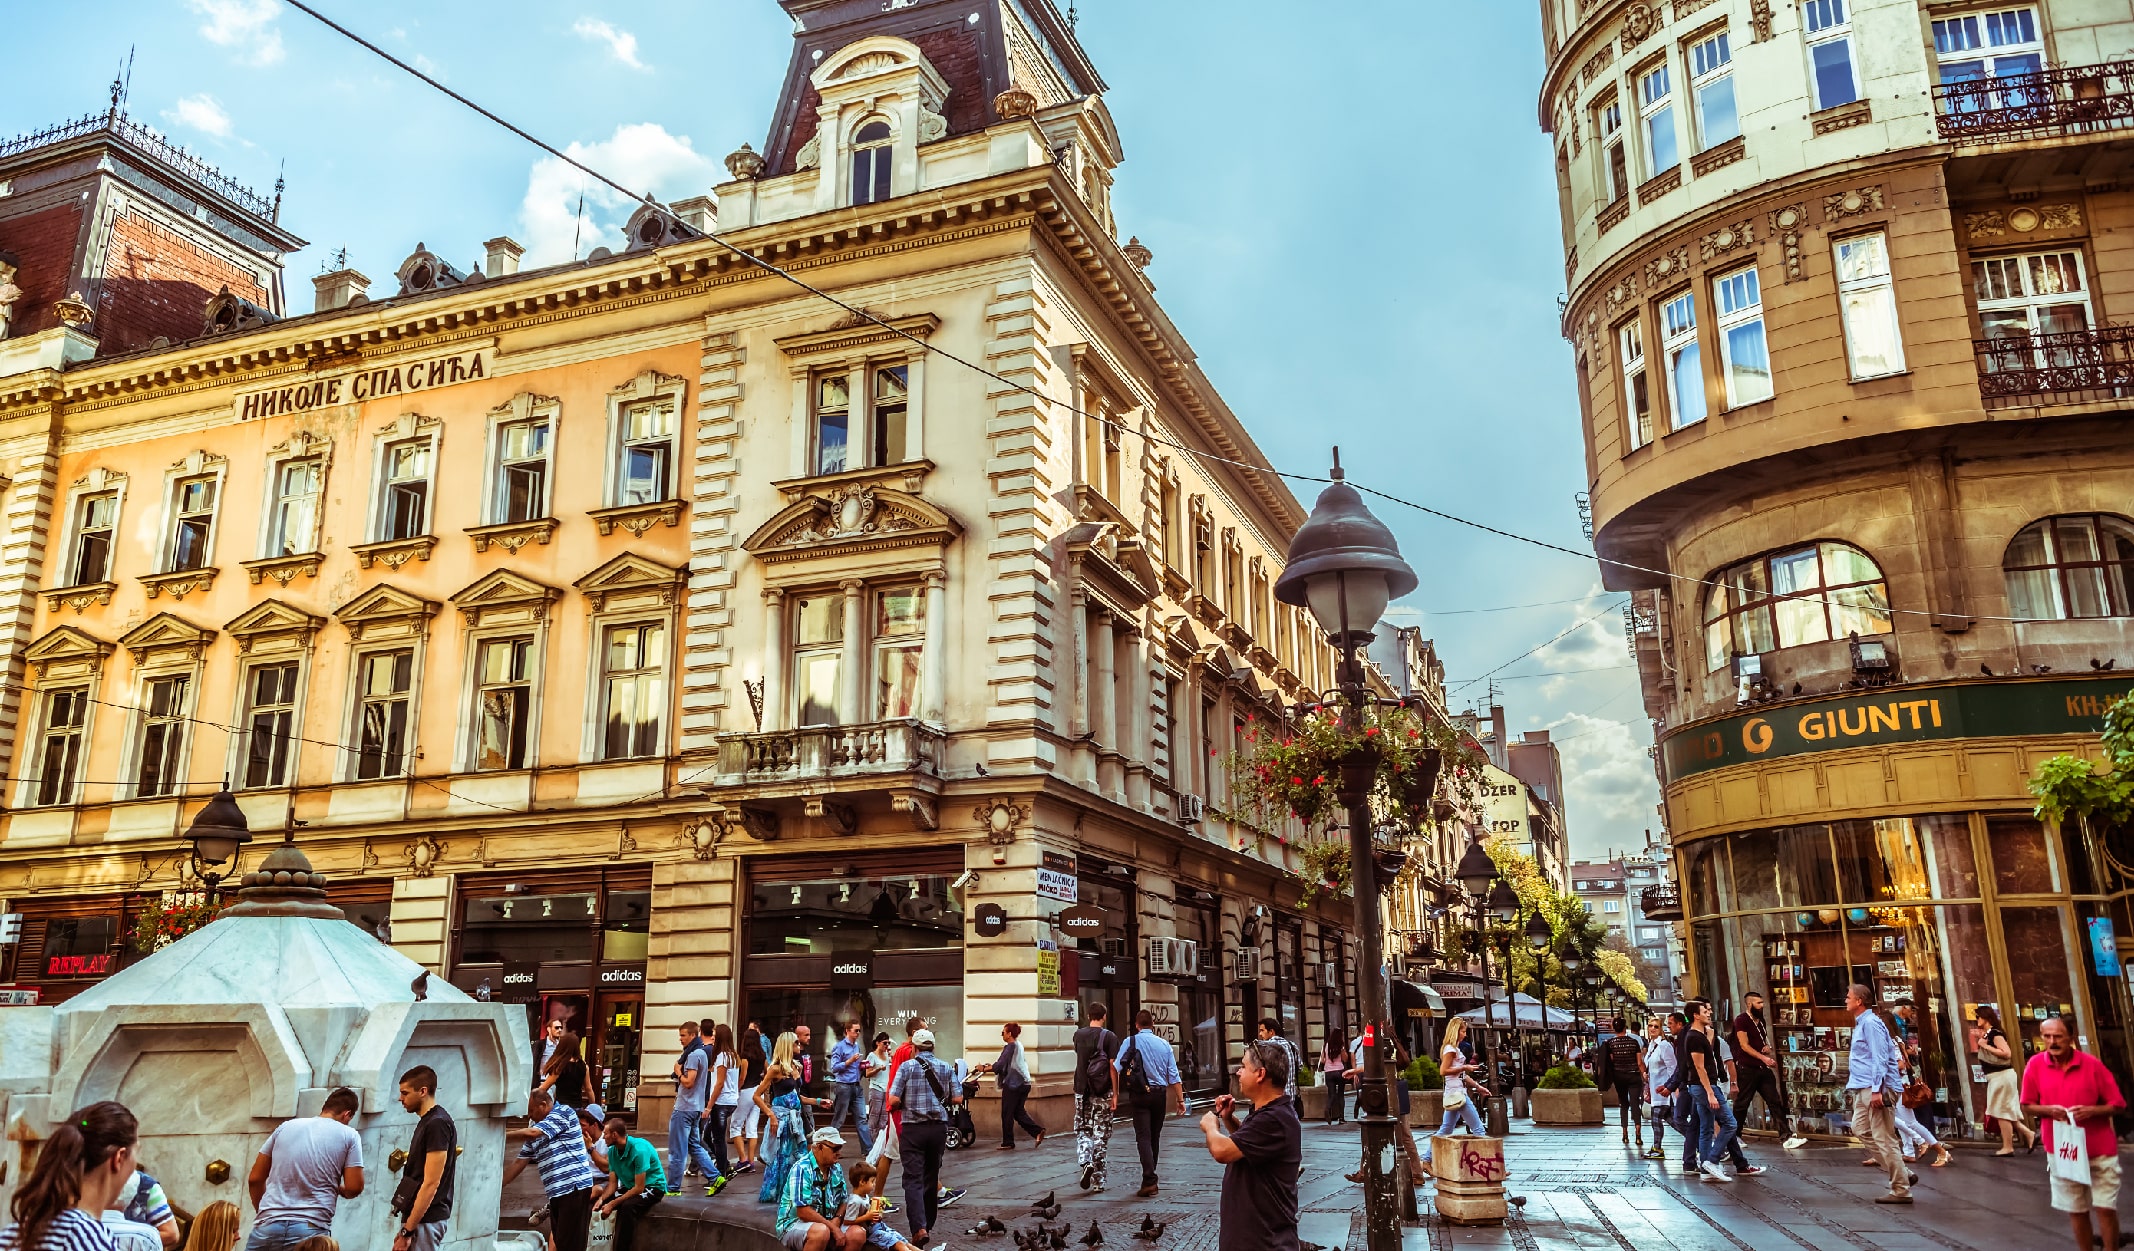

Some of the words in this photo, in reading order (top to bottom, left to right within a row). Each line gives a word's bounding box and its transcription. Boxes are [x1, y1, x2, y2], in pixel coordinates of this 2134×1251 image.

[241, 379, 342, 421] НИКОЛЕ
[351, 352, 484, 400] СПАСИЋА
[1798, 699, 1942, 742] GIUNTI
[1066, 917, 1100, 927] adidas
[47, 955, 111, 975] REPLAY
[833, 963, 868, 974] adidas
[503, 973, 534, 984] adidas
[601, 969, 642, 982] adidas
[897, 1009, 917, 1019] WIN
